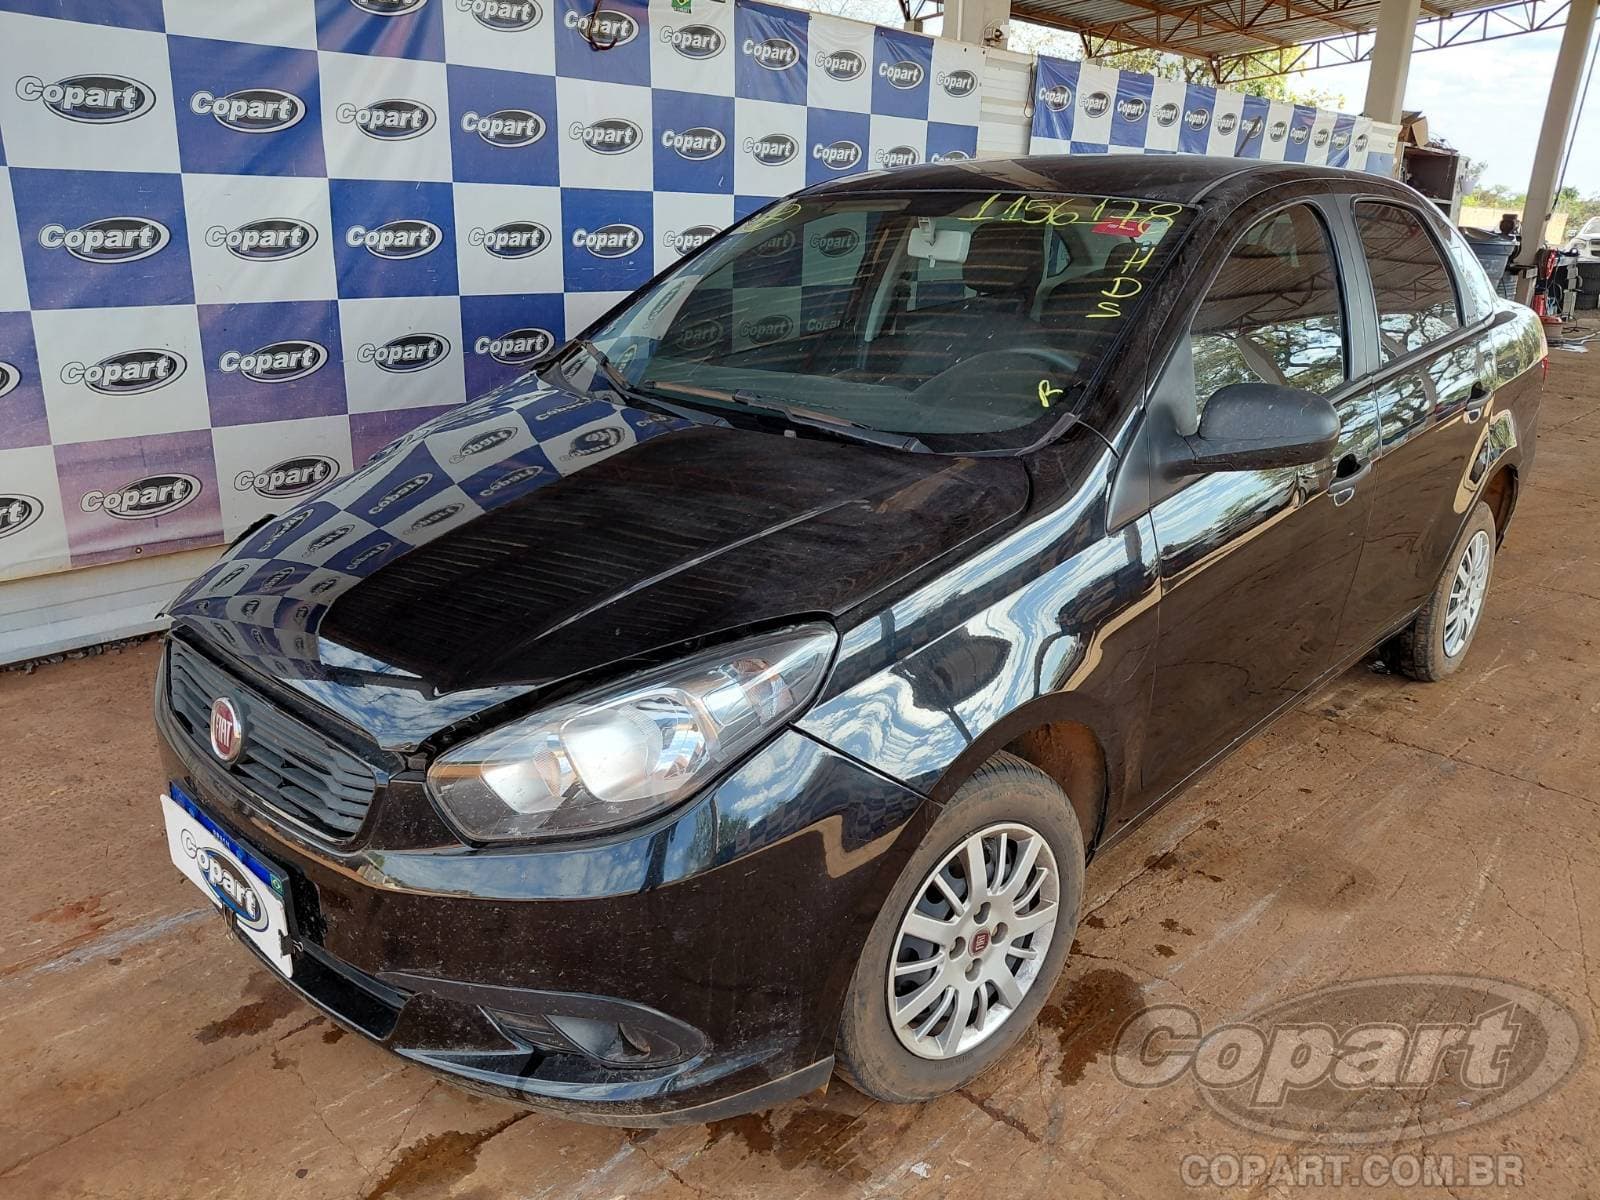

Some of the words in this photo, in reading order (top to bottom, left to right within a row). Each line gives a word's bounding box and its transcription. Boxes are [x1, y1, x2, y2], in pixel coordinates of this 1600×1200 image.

[660, 25, 718, 53] Copart
[743, 39, 792, 64] Copart
[815, 52, 858, 74] Copart
[879, 63, 920, 83] Copart
[936, 71, 973, 91] Copart
[16, 75, 137, 111] Copart
[1039, 87, 1068, 105] Copart
[1080, 93, 1107, 110] Copart
[190, 91, 292, 121] Copart
[336, 103, 424, 129] Copart
[1117, 99, 1142, 116] Copart
[1185, 111, 1207, 125] Copart
[461, 111, 537, 138] Copart
[569, 122, 634, 145] Copart
[662, 130, 718, 154] Copart
[743, 137, 792, 160] Copart
[813, 144, 857, 165] Copart
[876, 149, 914, 168] Copart
[39, 223, 154, 254] Copart
[205, 225, 303, 252] Copart
[346, 225, 431, 250] Copart
[468, 227, 542, 250] Copart
[571, 228, 636, 249] Copart
[810, 232, 852, 251] Copart
[740, 320, 787, 340] Copart
[357, 339, 439, 365] Copart
[474, 333, 545, 355] Copart
[60, 353, 173, 386] Copart
[218, 345, 315, 374] Copart
[234, 461, 326, 491] Copart
[80, 479, 187, 513] Copart
[215, 712, 233, 748] FIAT
[180, 828, 257, 920] Copart
